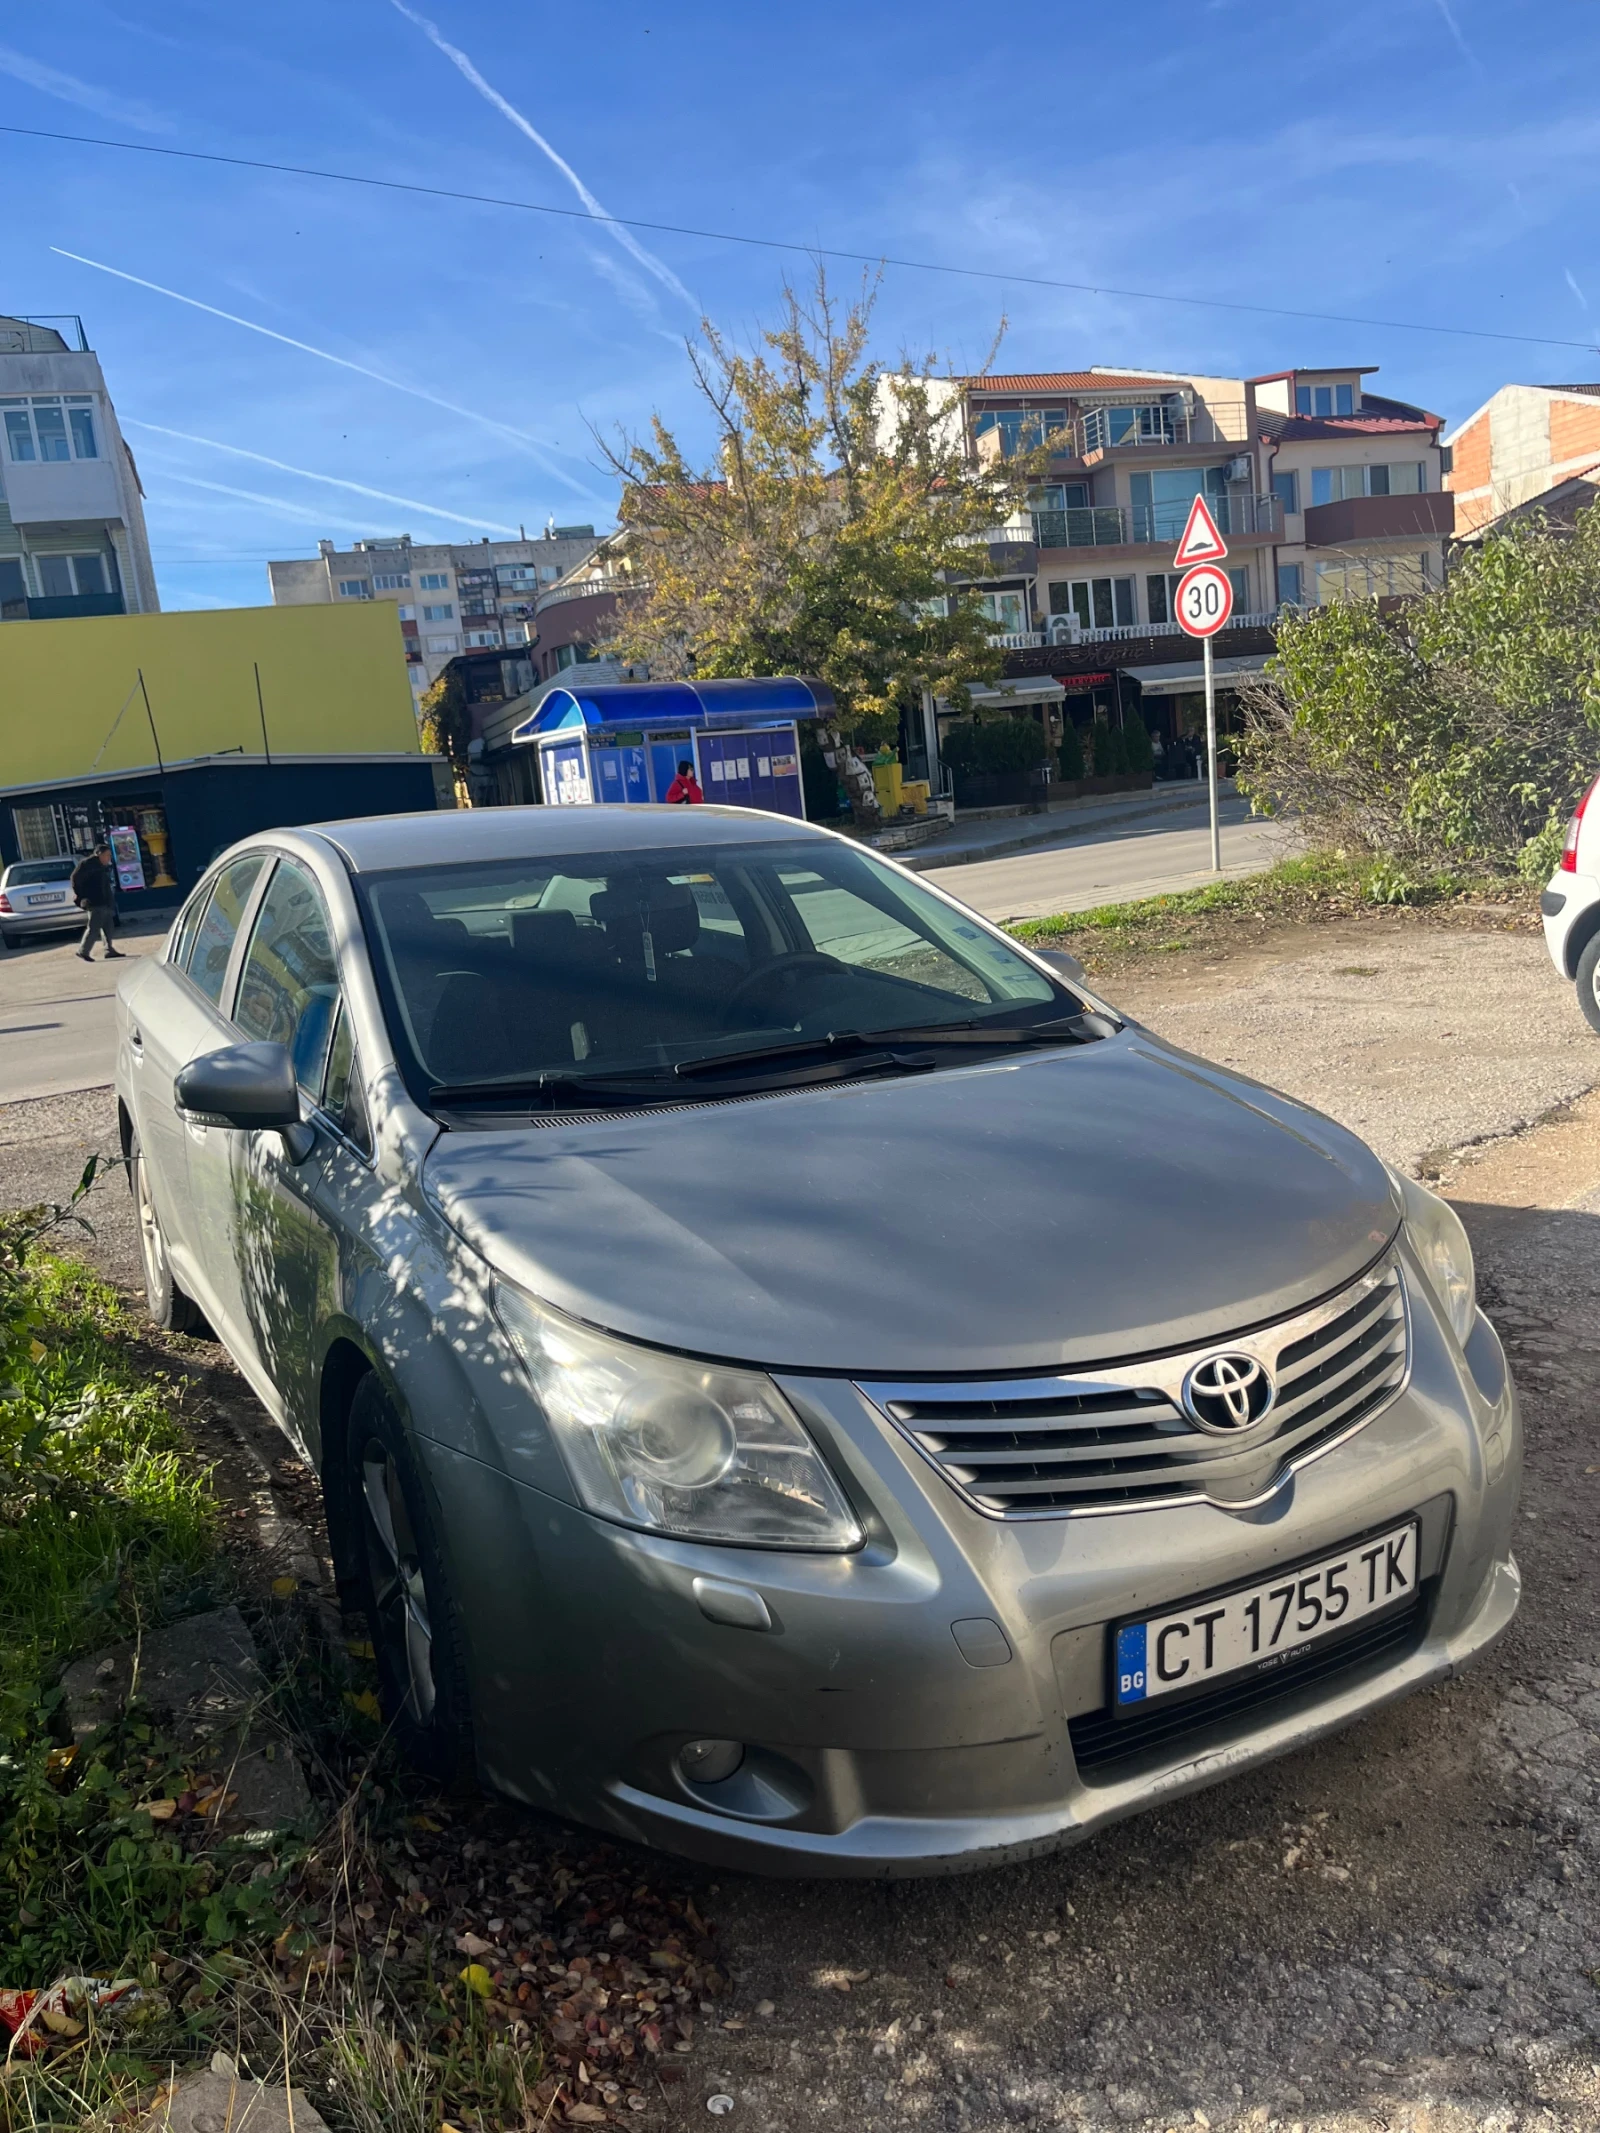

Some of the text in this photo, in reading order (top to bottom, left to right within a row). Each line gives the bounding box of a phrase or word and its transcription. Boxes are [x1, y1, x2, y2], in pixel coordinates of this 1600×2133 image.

[1189, 583, 1219, 618] 30
[1156, 1532, 1409, 1682] CT 1755 TK
[1290, 1643, 1312, 1658] AUTO
[1120, 1671, 1144, 1693] BG
